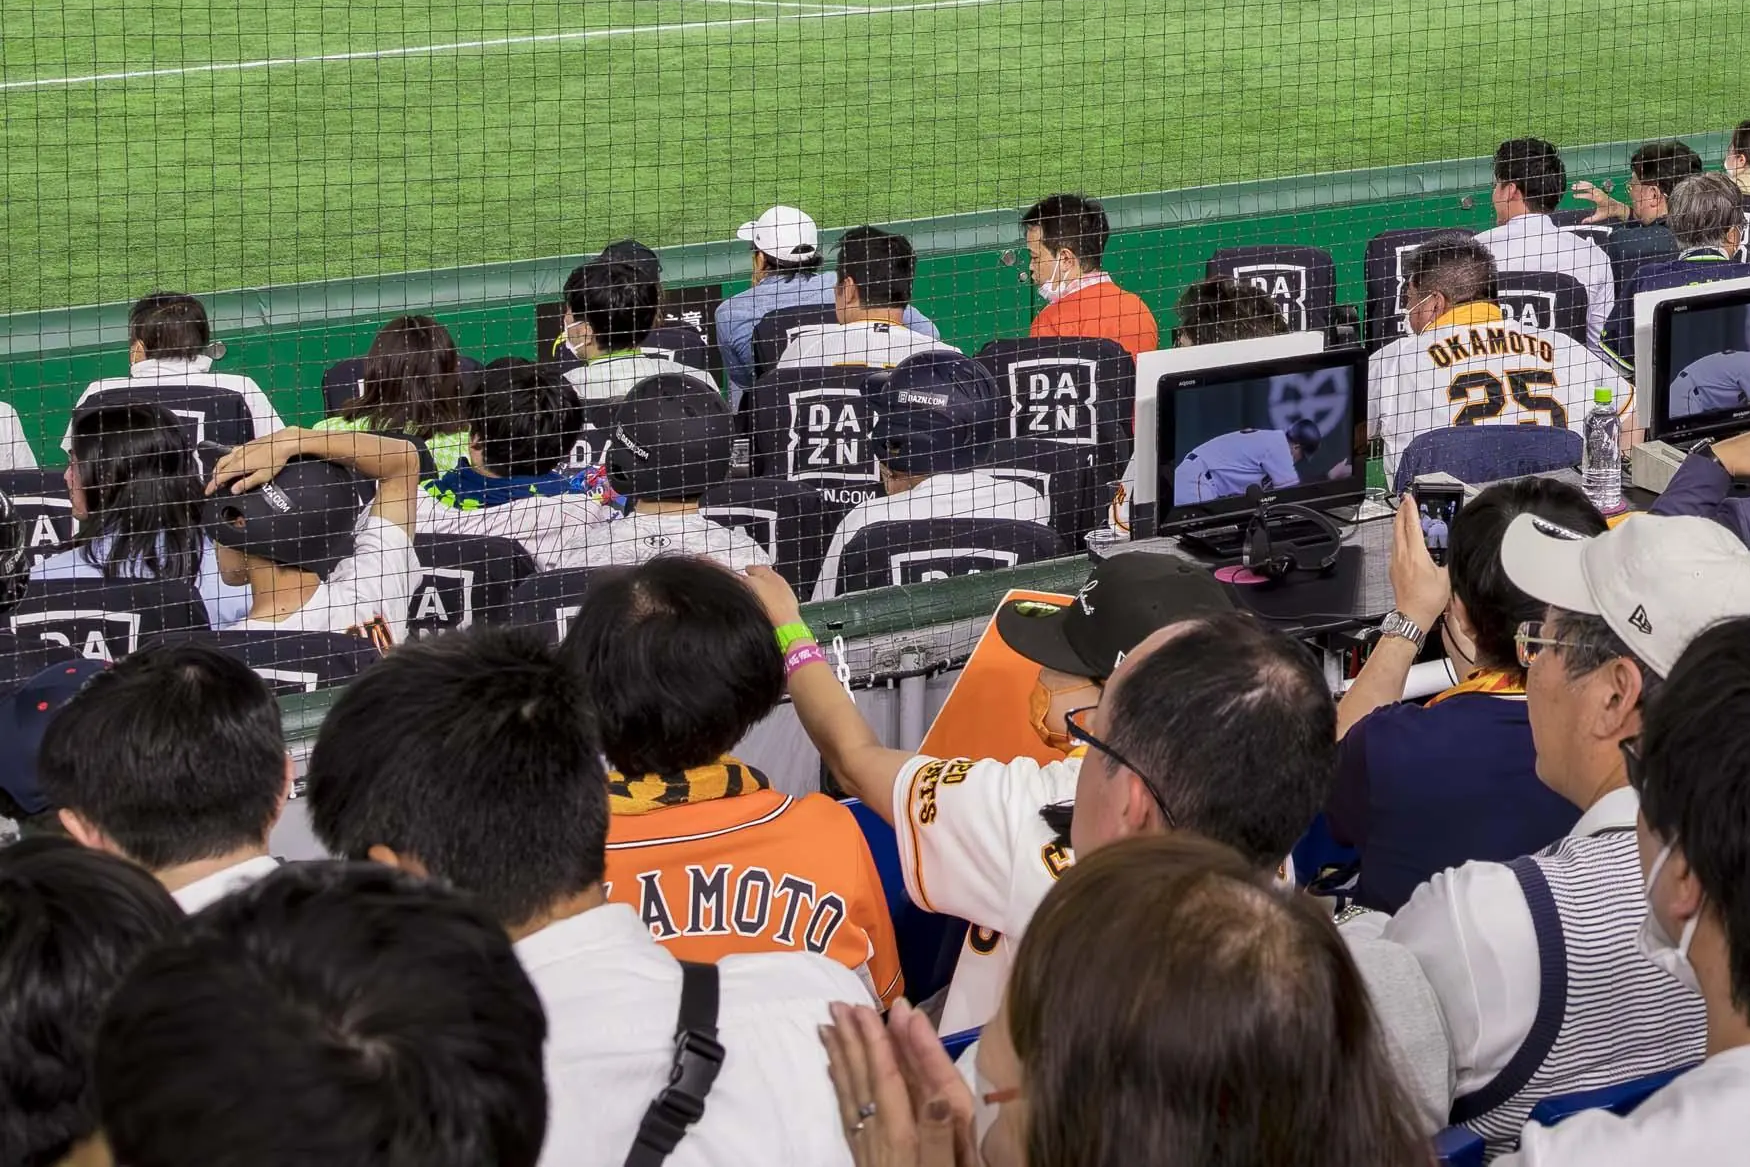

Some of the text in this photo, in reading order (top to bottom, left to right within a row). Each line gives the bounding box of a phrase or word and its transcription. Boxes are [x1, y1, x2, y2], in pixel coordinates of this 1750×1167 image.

[1426, 327, 1553, 369] OKAMOTO
[908, 394, 945, 407] DAZN.COM
[1028, 372, 1079, 400] DA
[1446, 367, 1568, 428] 25
[807, 403, 862, 433] DA
[1028, 404, 1077, 431] ZN
[807, 438, 860, 465] ZN
[604, 863, 848, 956] AMOTO
